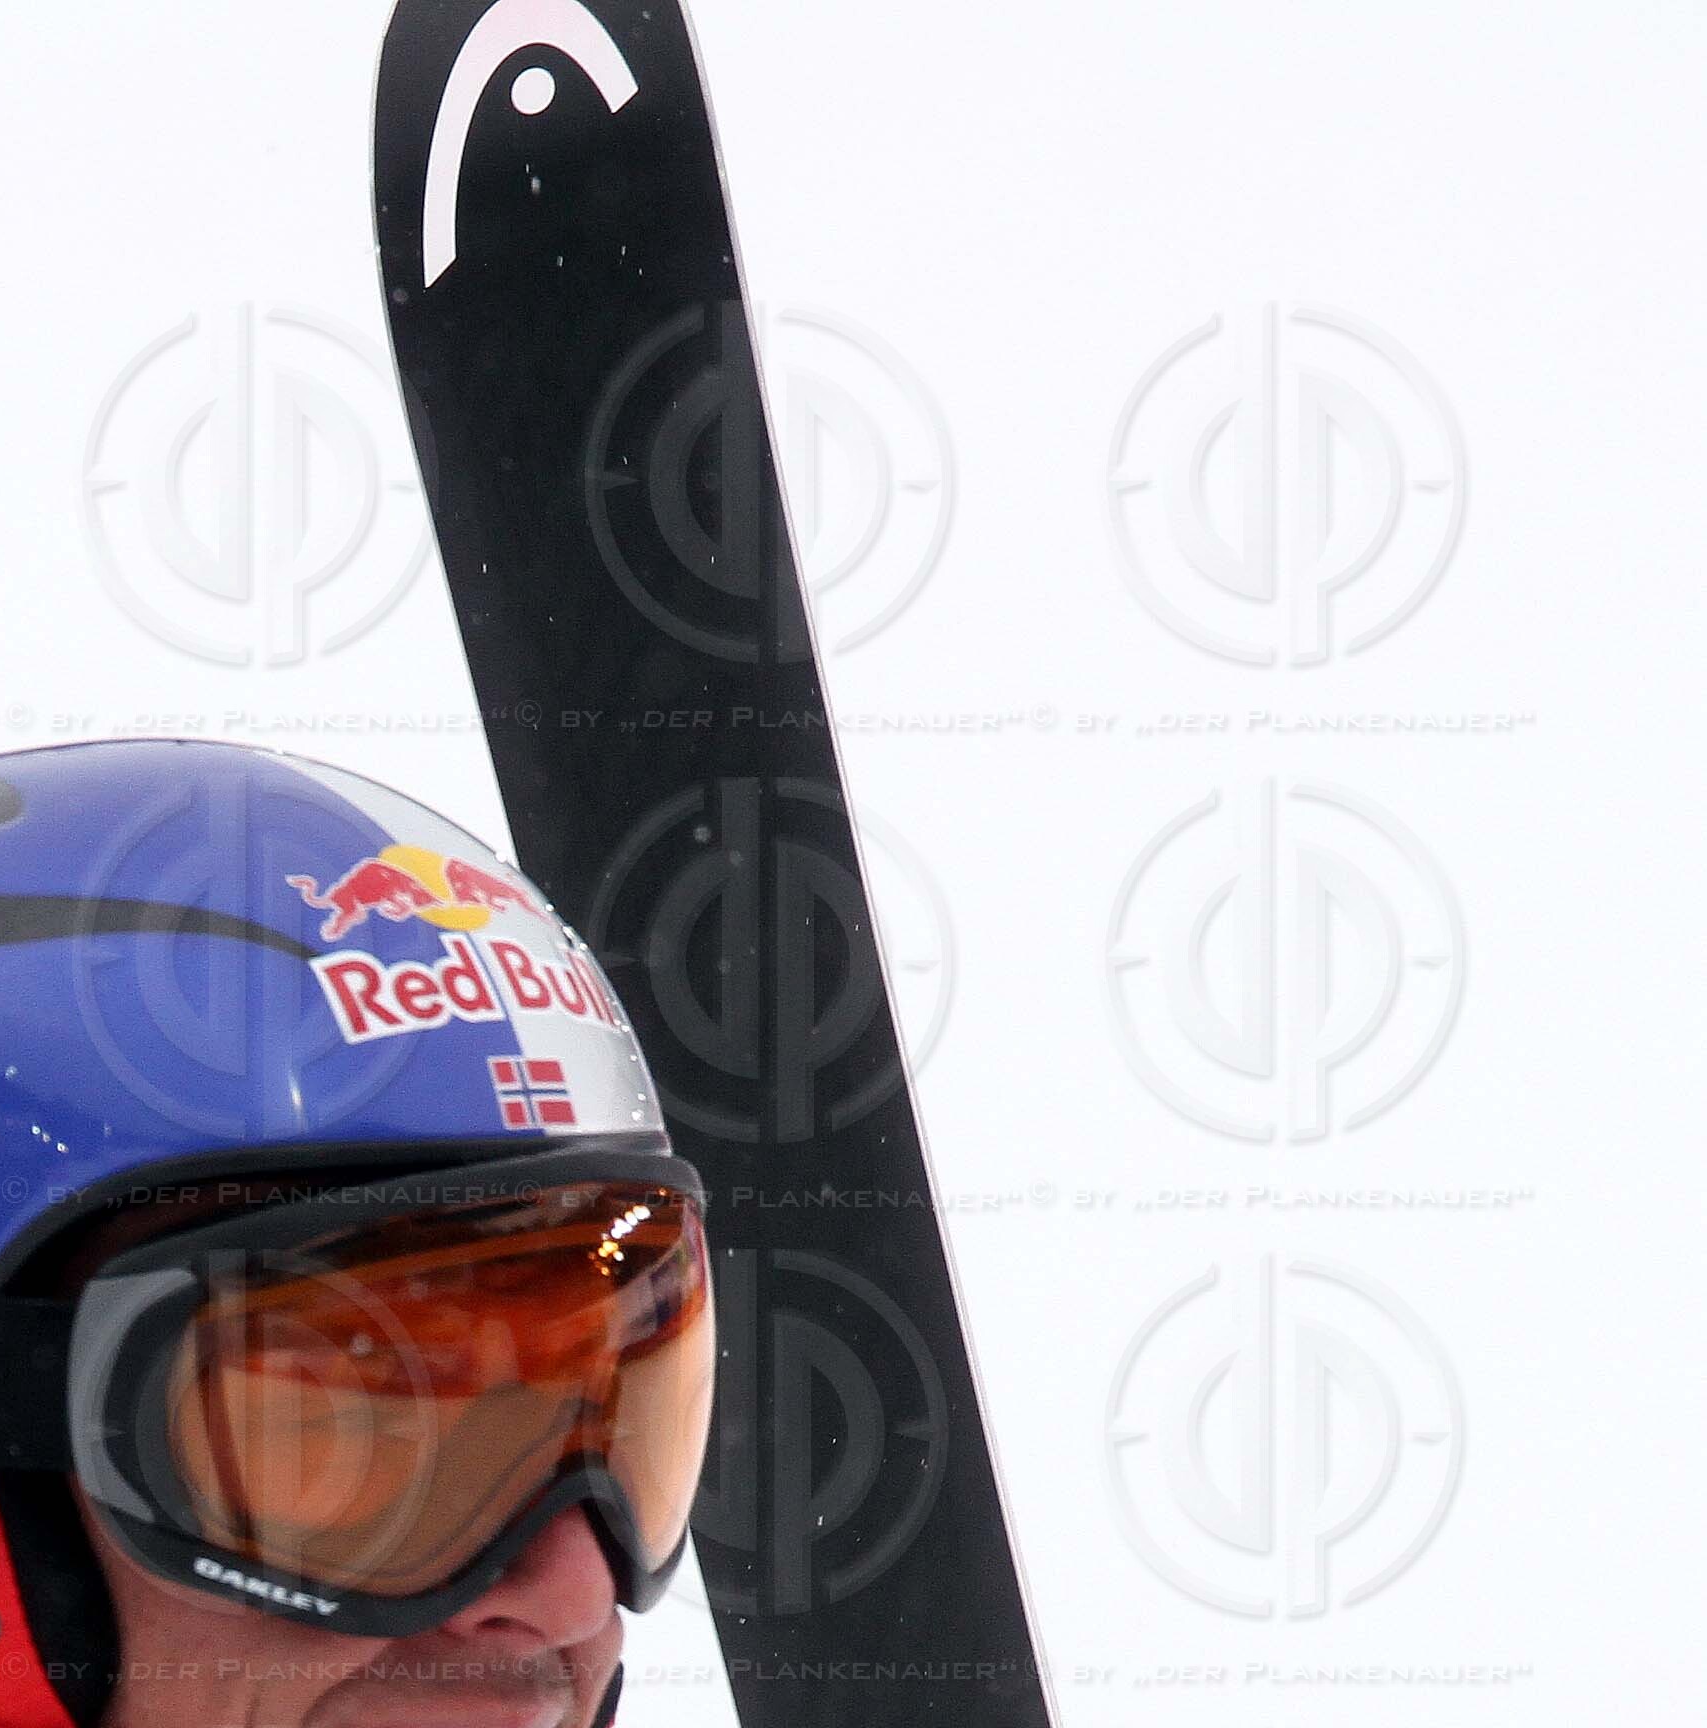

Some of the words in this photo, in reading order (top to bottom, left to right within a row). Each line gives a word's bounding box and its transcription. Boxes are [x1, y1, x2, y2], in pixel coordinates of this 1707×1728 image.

[321, 940, 495, 1034] Red
[495, 942, 616, 1025] Bull
[194, 1557, 341, 1616] OAKLEY
